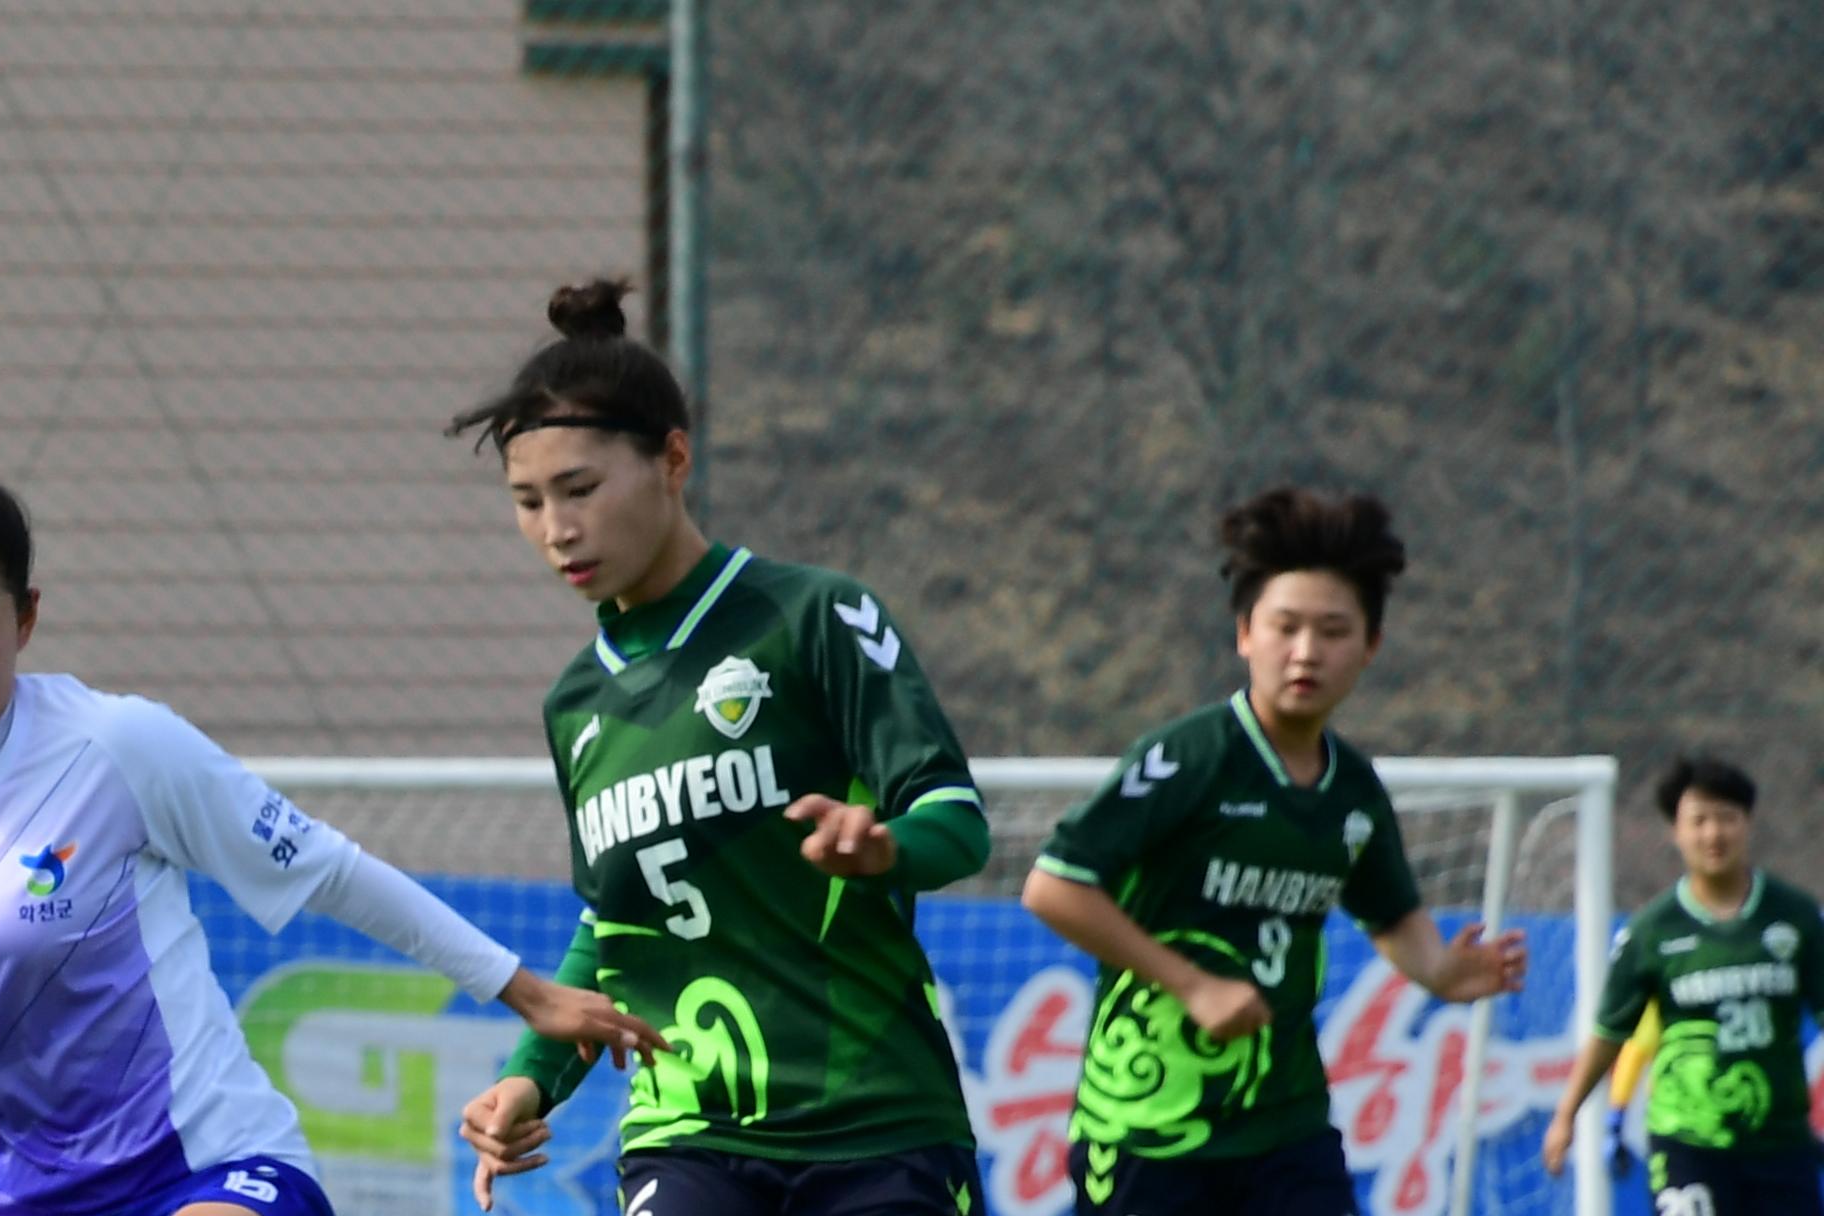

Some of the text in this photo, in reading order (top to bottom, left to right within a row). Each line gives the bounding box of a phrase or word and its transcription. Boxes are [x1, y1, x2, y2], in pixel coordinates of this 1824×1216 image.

[635, 838, 712, 940] 5
[1202, 857, 1343, 915] HANBYE
[1251, 917, 1293, 988] 9
[1716, 1000, 1774, 1052] 20
